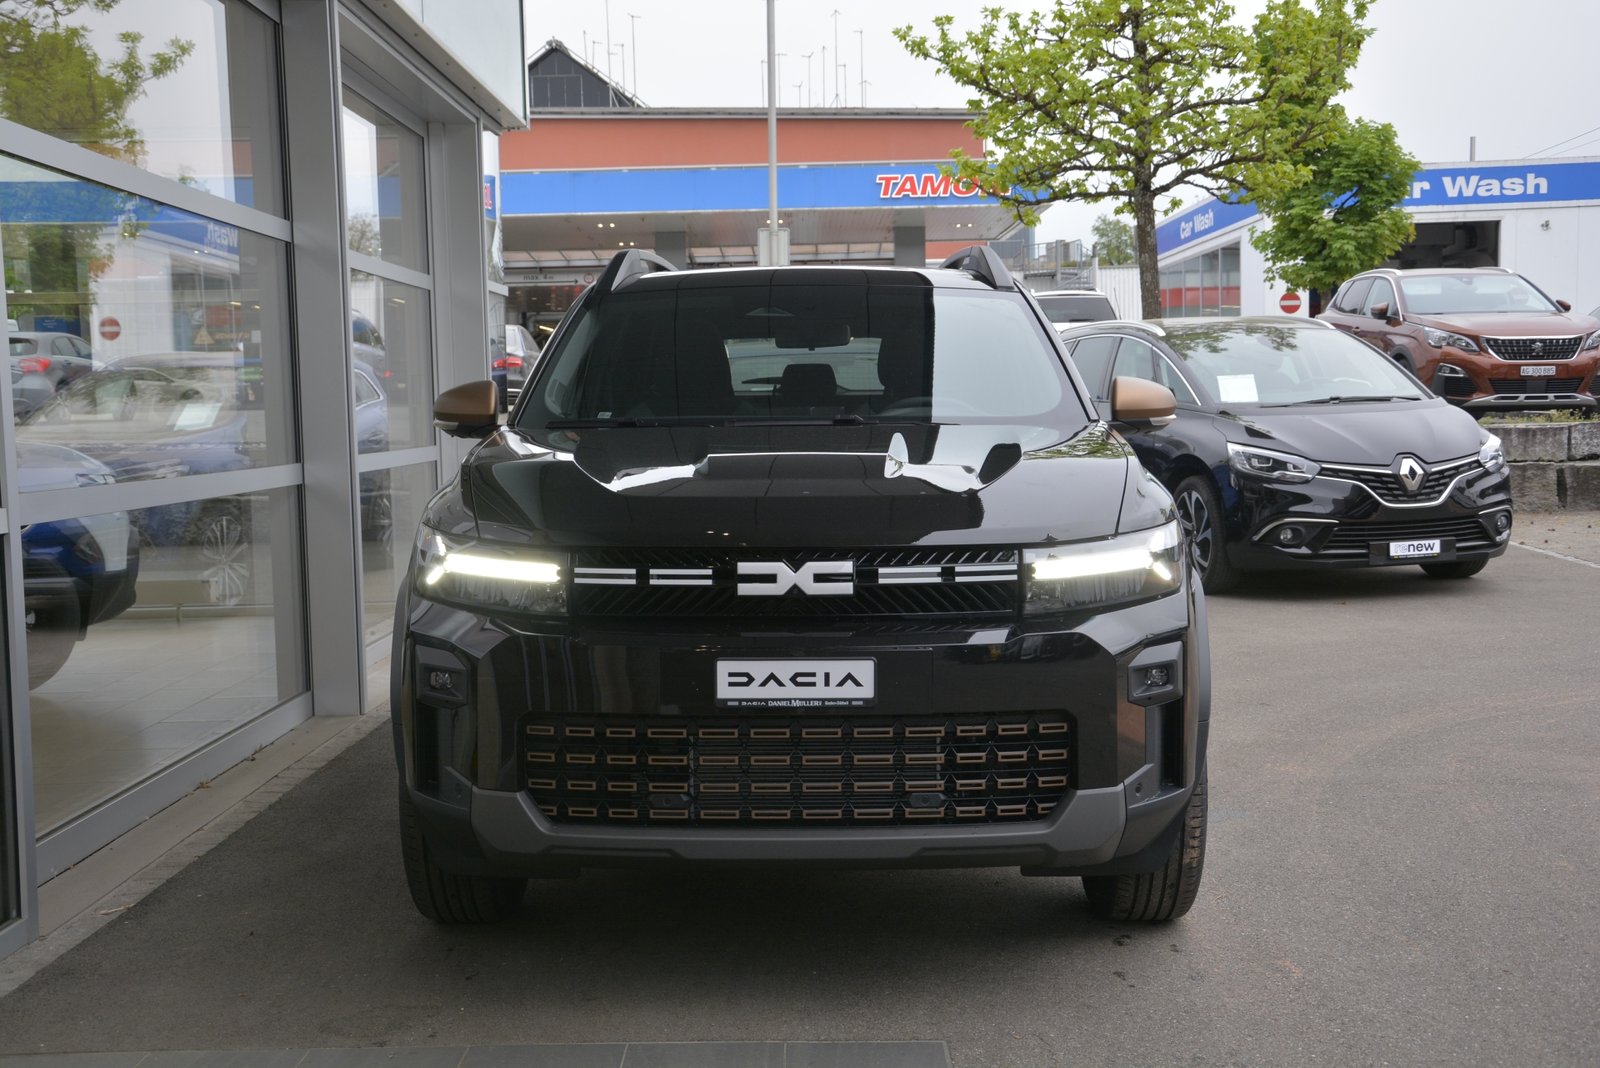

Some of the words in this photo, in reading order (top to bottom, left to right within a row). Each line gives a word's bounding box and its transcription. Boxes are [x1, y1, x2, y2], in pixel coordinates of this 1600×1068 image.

[1442, 173, 1548, 198] Wash
[1180, 221, 1193, 240] Car
[1193, 208, 1214, 233] Wash
[1521, 367, 1530, 375] AG
[727, 671, 864, 688] DACIA
